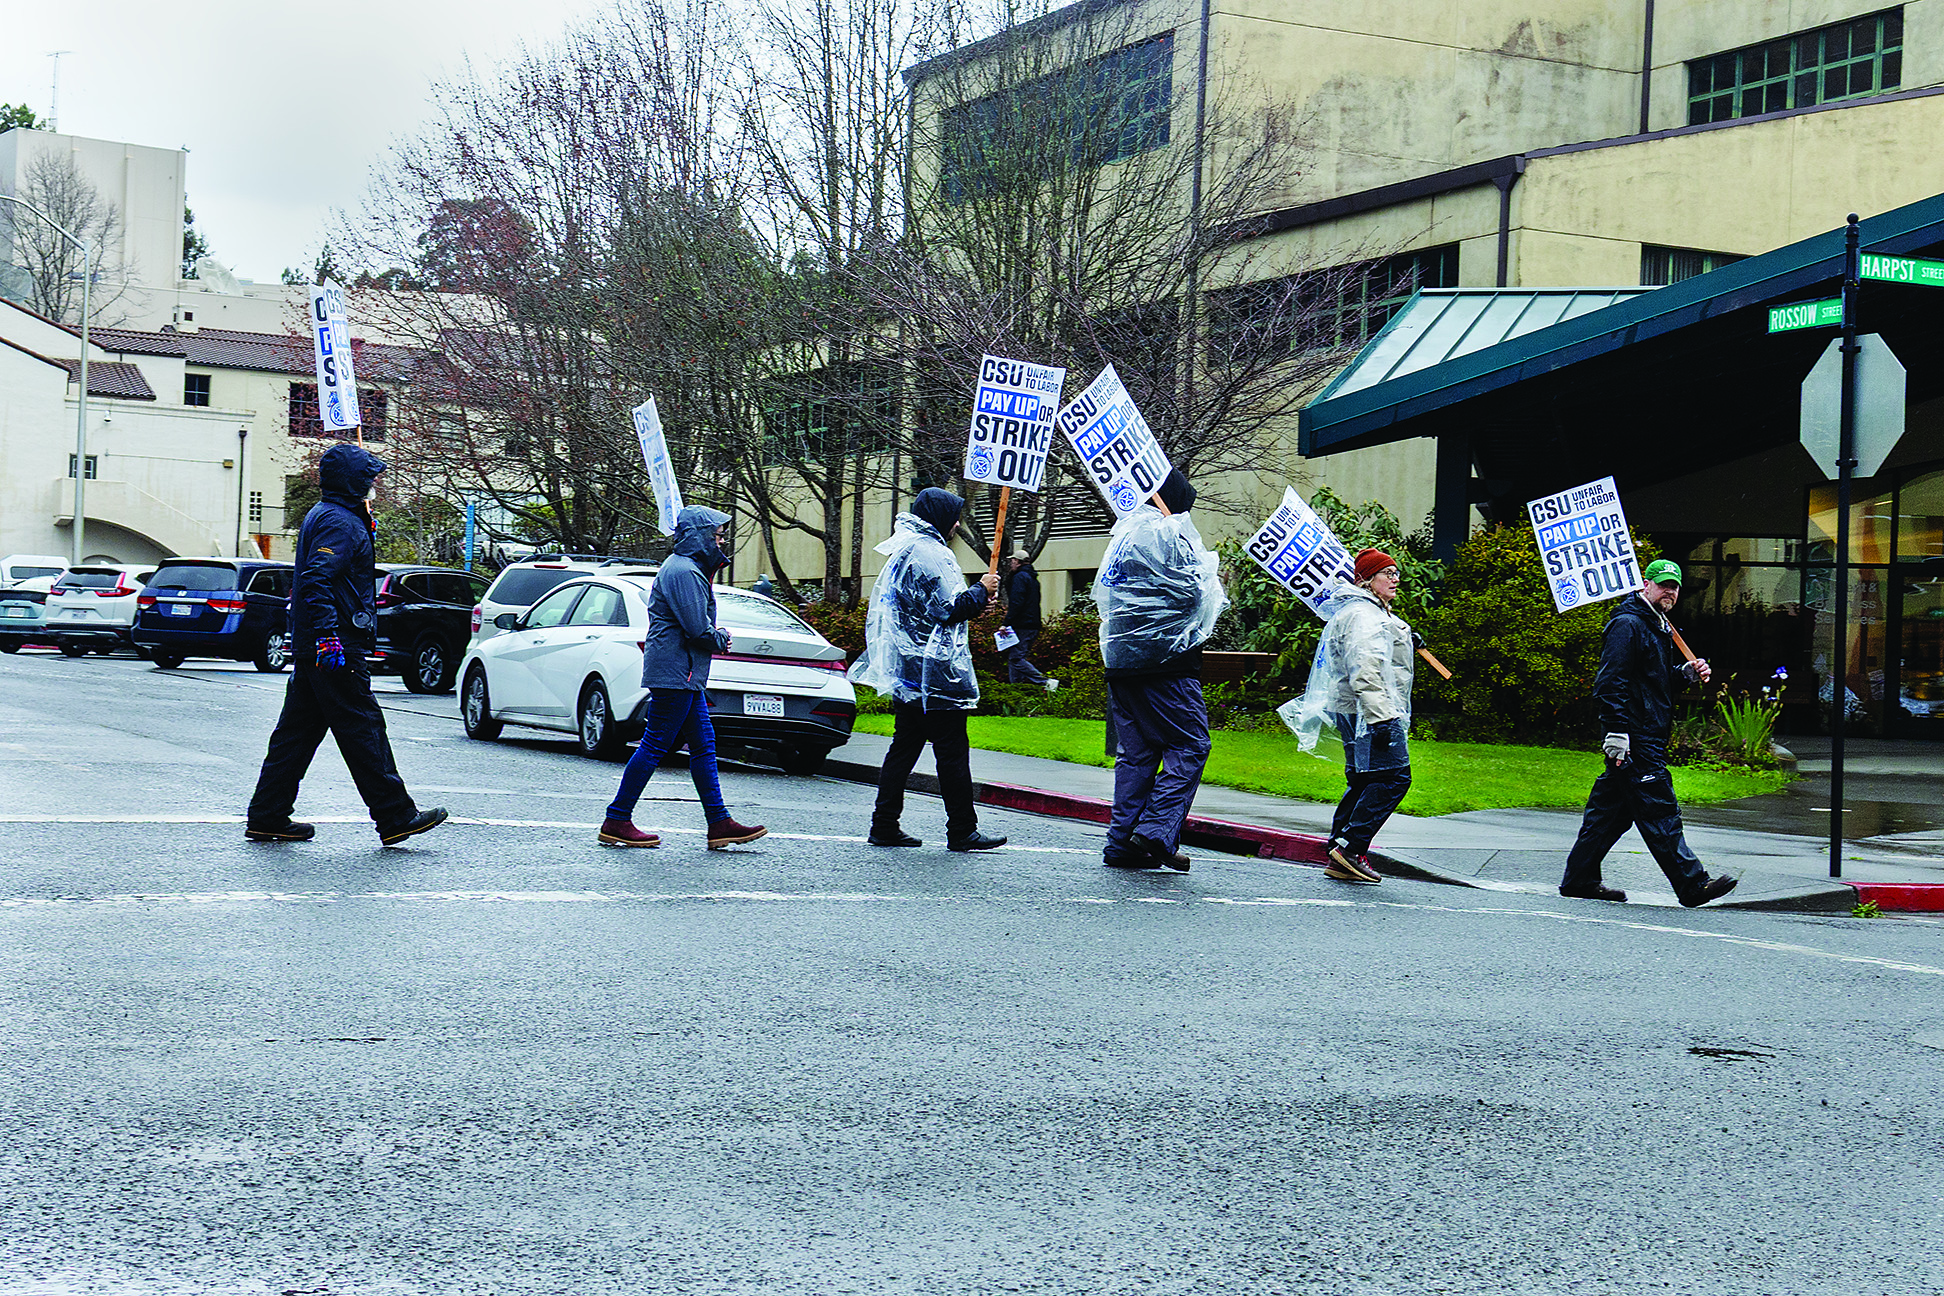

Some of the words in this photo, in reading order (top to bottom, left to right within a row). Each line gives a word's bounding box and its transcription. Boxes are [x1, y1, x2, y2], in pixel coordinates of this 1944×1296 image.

[1861, 255, 1916, 281] HARPST
[1771, 305, 1818, 330] ROSSOW
[982, 359, 1025, 387] CSU
[1025, 378, 1036, 389] TO
[1038, 381, 1059, 394] LABOR
[1026, 366, 1055, 381] UNFAIR
[1090, 373, 1111, 399] UNFAIR
[980, 389, 1013, 413] PAY
[1014, 396, 1038, 416] UP
[1039, 405, 1054, 423] OR
[1096, 396, 1107, 408] TO
[1105, 378, 1121, 401] LABOR
[1060, 393, 1098, 435] CSU
[1078, 424, 1109, 456] PAY
[1102, 408, 1123, 435] UP
[1120, 399, 1136, 421] OR
[973, 414, 1051, 453] STRIKE
[1090, 415, 1150, 485] STRIKE
[997, 449, 1044, 487] OUT
[1130, 441, 1167, 494] OUT
[1531, 494, 1572, 524] CSU
[1571, 484, 1604, 502] UNFAIR
[1574, 500, 1586, 511] TO
[1586, 491, 1616, 508] LABOR
[1284, 517, 1297, 530] TO
[1541, 522, 1572, 548] PAY
[1573, 516, 1598, 537] UP
[1600, 513, 1621, 532] OR
[1248, 520, 1288, 562] CSU
[1272, 543, 1304, 578] PAY
[1294, 527, 1319, 555] UP
[1546, 530, 1631, 576] STRIKE
[1581, 557, 1637, 598] OUT
